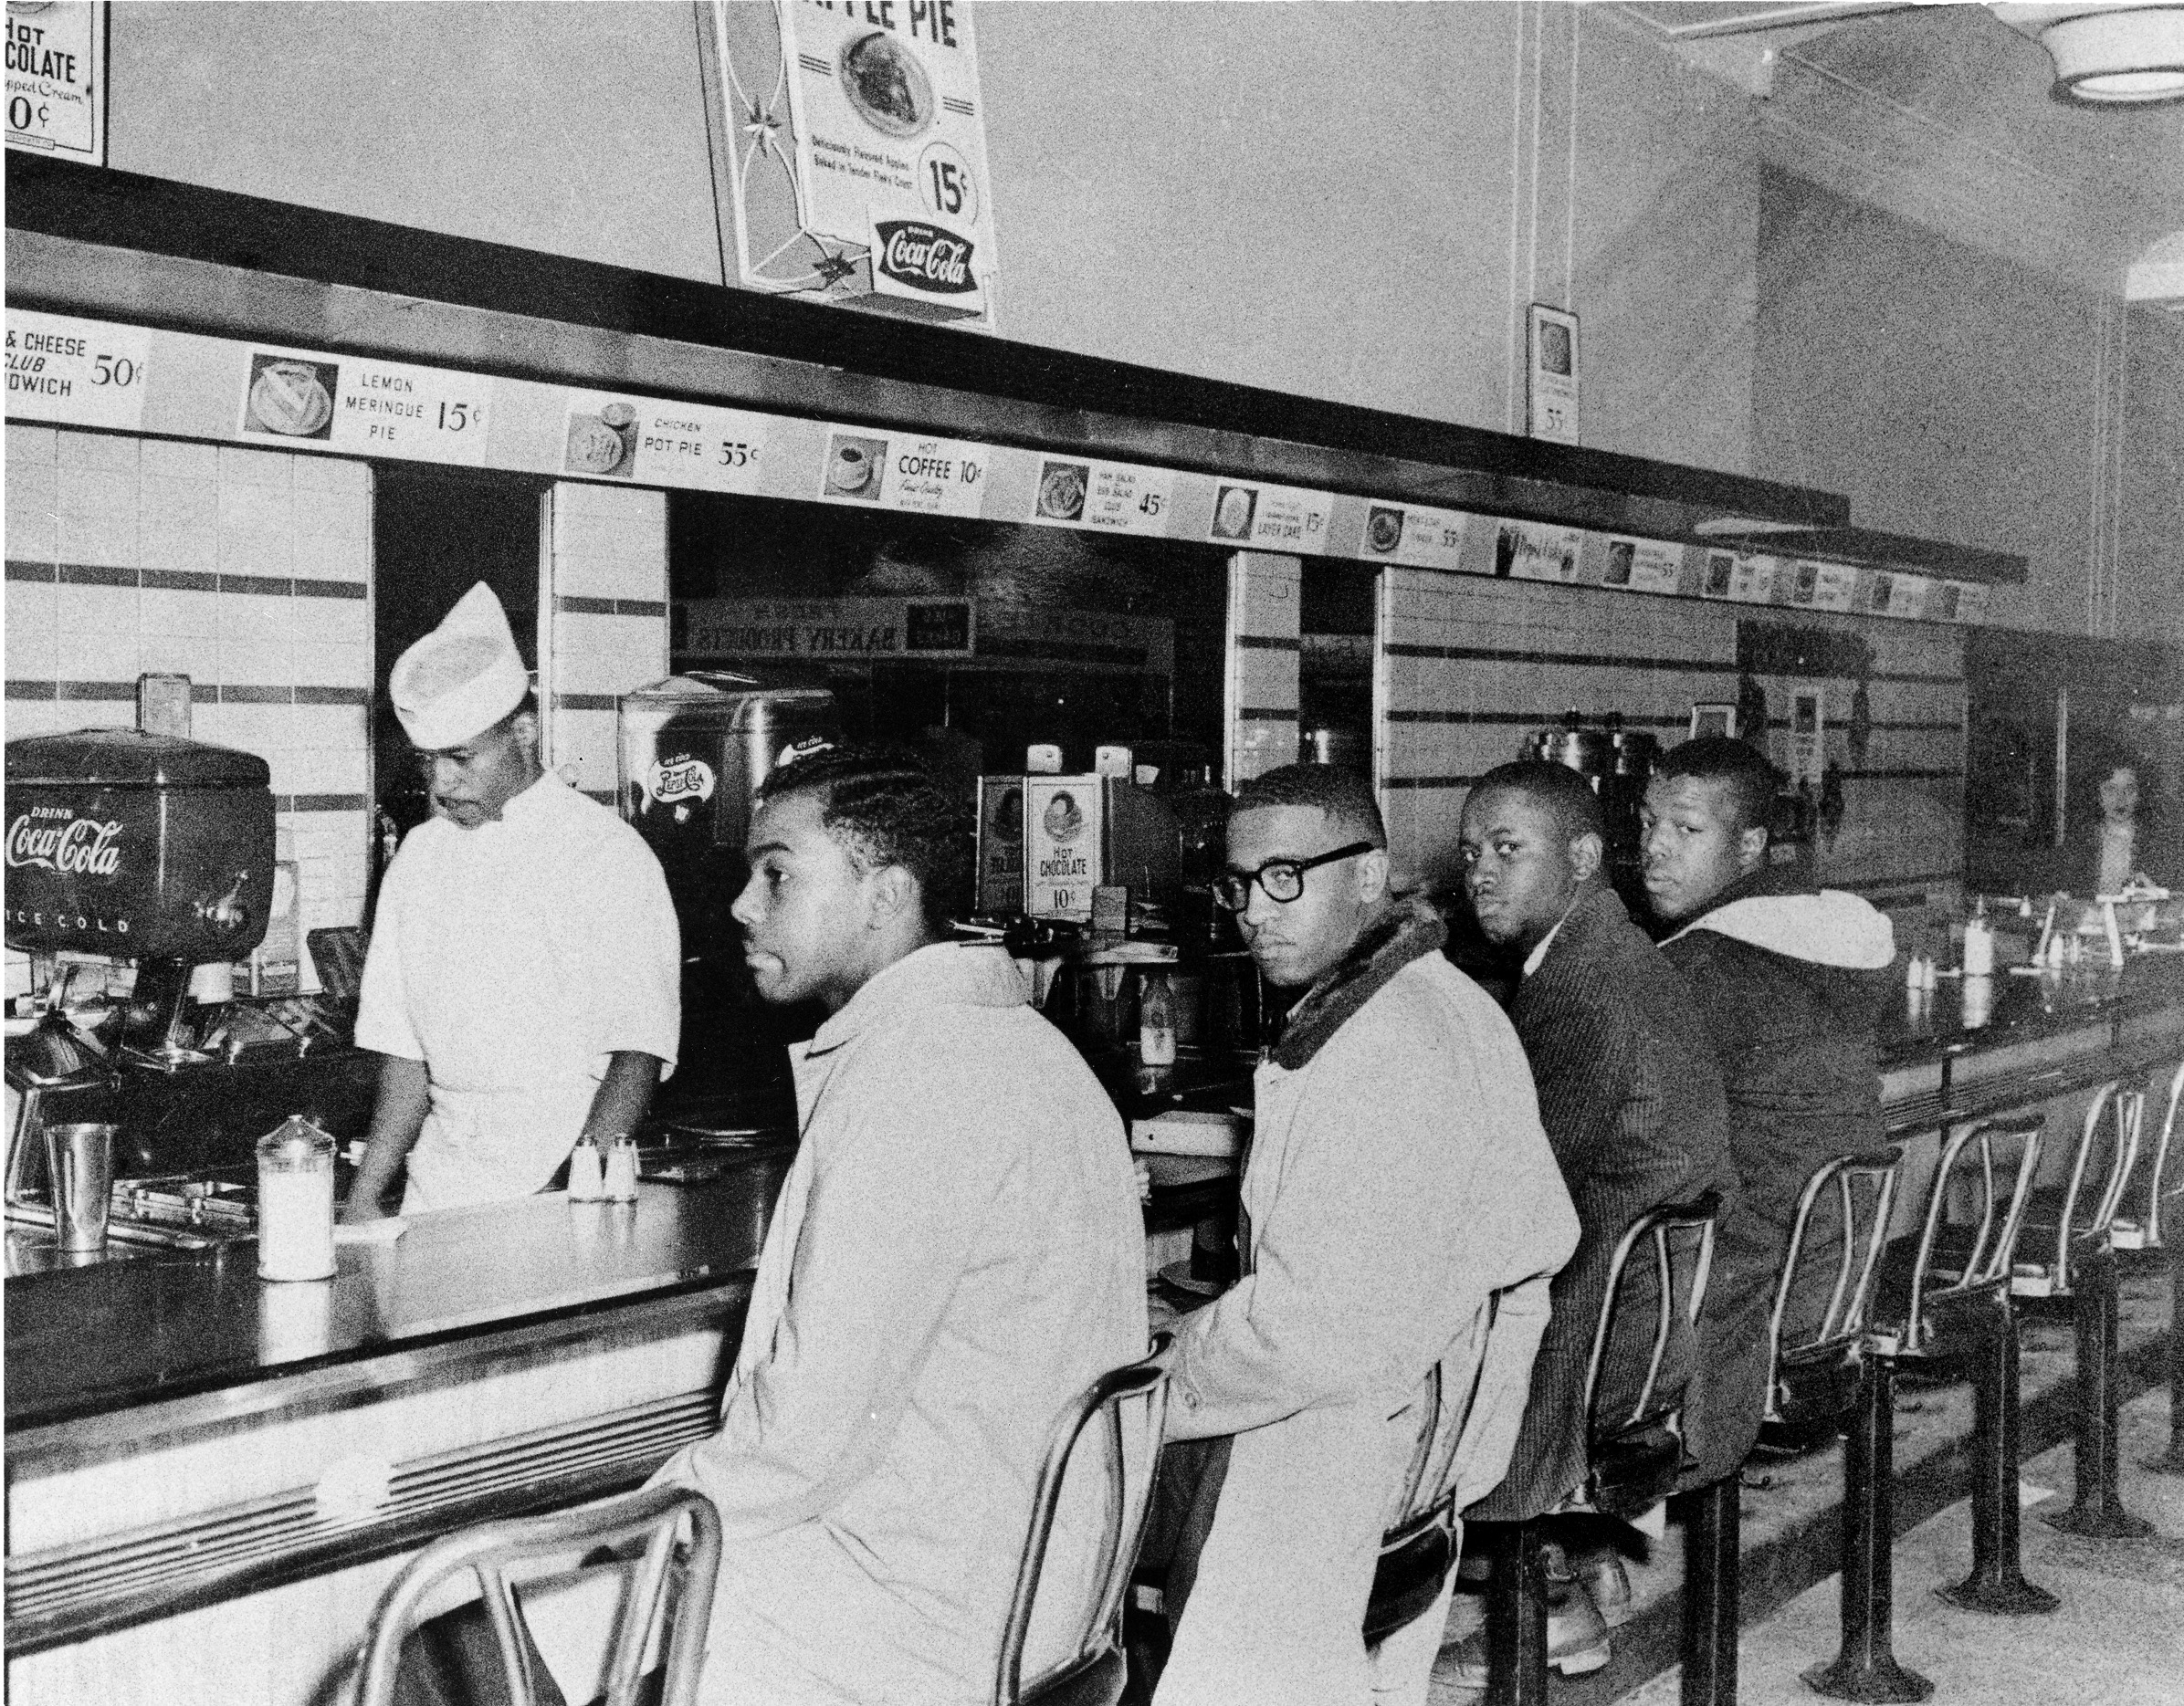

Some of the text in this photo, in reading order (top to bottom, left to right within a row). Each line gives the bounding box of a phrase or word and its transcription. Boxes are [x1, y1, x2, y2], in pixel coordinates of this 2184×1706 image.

[910, 0, 956, 47] PIE
[887, 229, 967, 284] Coca-Cola
[25, 332, 87, 357] CHEESE
[362, 373, 413, 392] LEMON
[345, 396, 424, 418] MERINGUE
[369, 424, 395, 440] PIE
[655, 418, 701, 432] CHICKEN
[645, 436, 702, 456] POT PIE
[919, 443, 937, 455] HOT
[898, 455, 951, 479] COFFEE
[31, 807, 73, 819] DRINK
[5, 814, 124, 874] Coca-Cola
[1054, 846, 1073, 859] HOT
[1040, 858, 1087, 877] CHOCOLATE
[5, 909, 129, 933] ICE COLD
